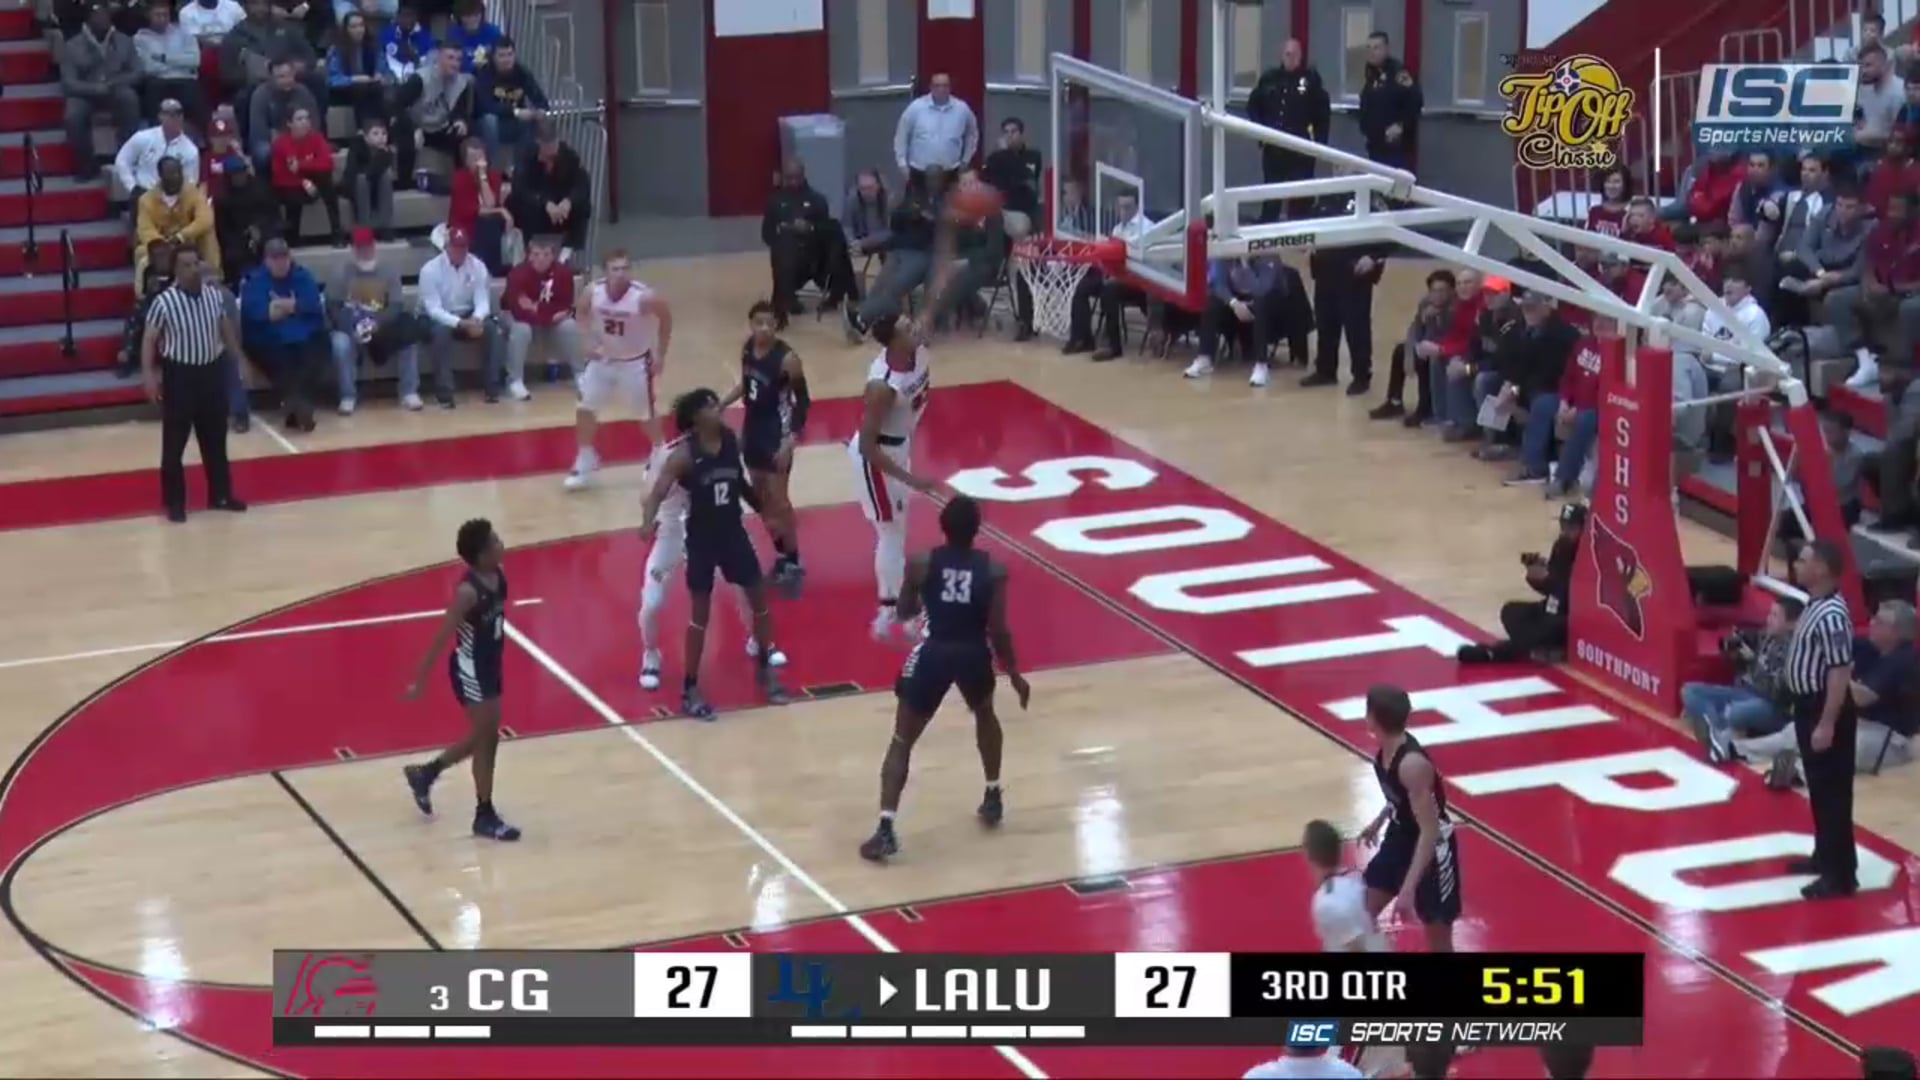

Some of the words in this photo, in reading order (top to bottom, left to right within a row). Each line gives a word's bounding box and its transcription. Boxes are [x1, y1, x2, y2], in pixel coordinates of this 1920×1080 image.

[604, 319, 624, 336] 21
[749, 378, 758, 401] 5
[714, 482, 730, 506] 12
[941, 568, 972, 603] 33
[1577, 638, 1660, 696] SOUTHPORT
